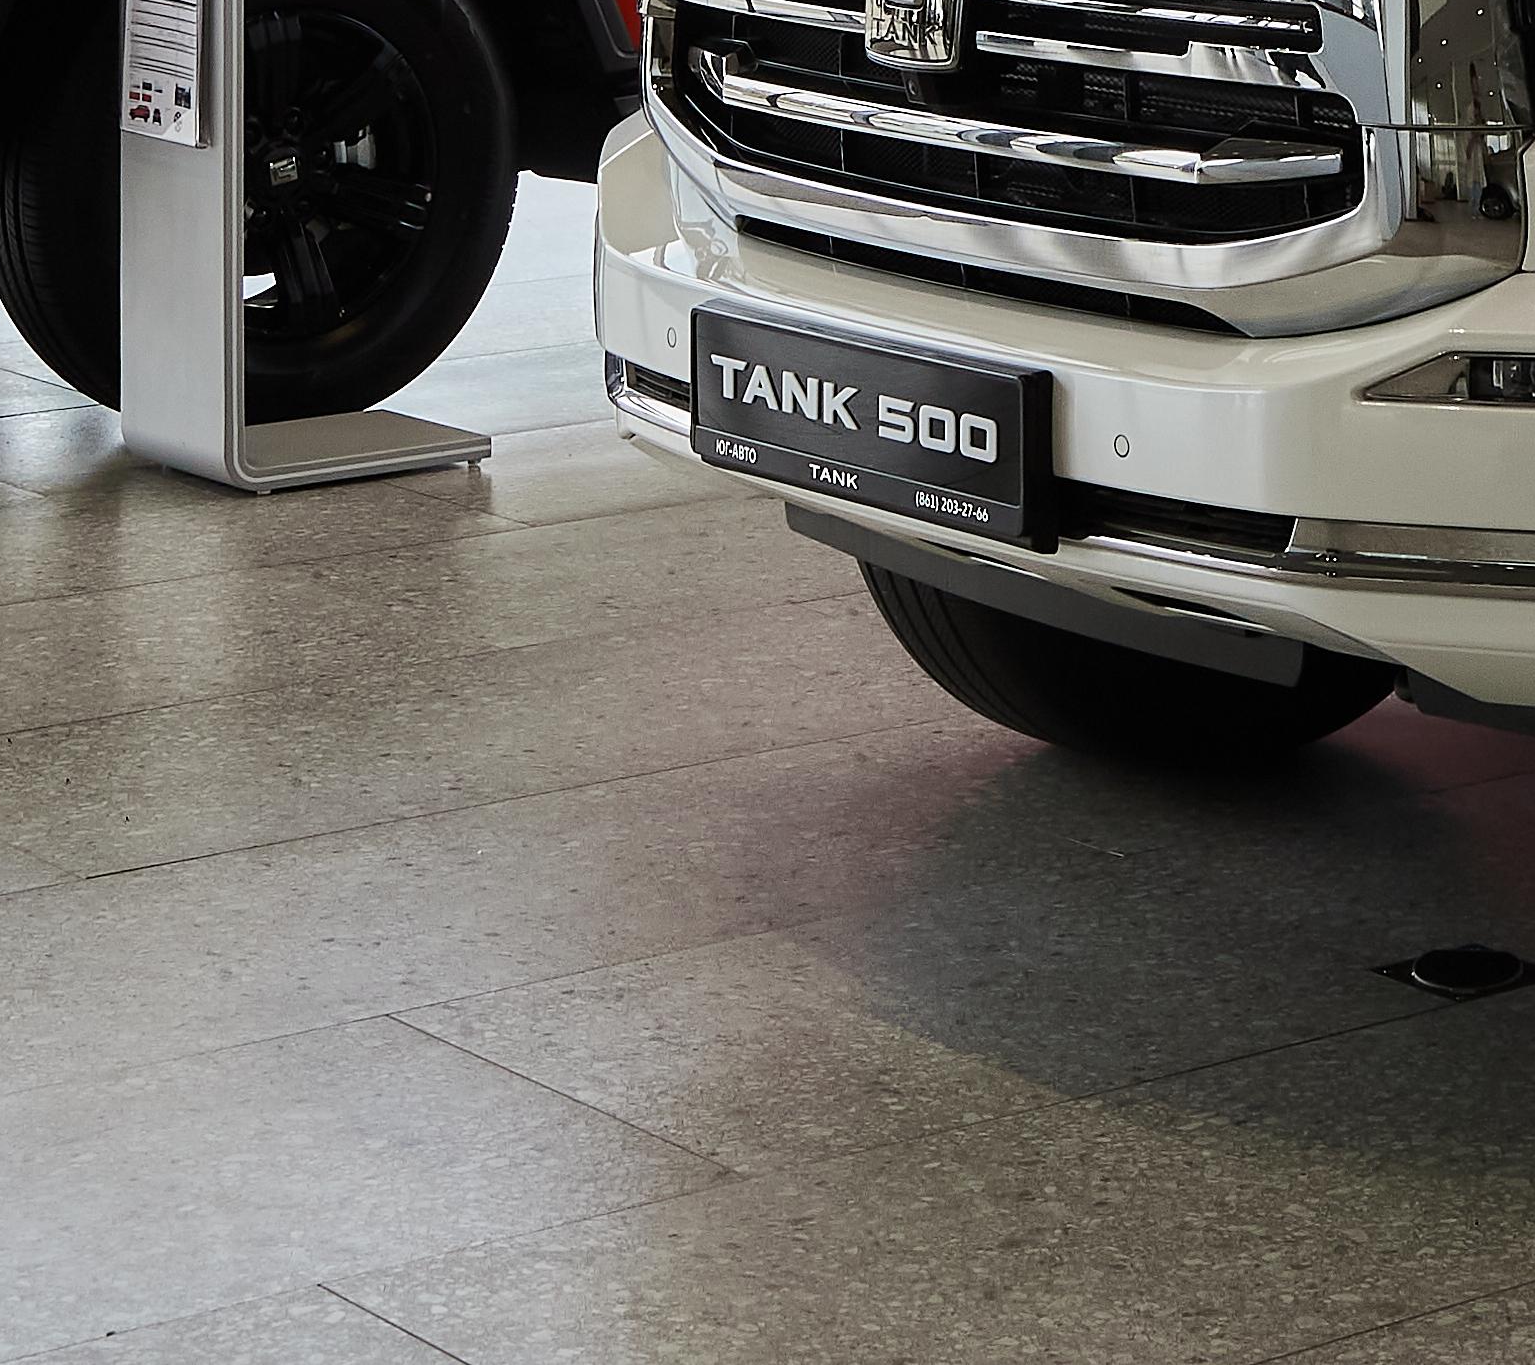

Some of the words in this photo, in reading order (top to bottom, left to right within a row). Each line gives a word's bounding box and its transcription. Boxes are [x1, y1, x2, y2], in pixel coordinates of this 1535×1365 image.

[872, 16, 939, 50] TANK
[710, 353, 861, 431] TANK
[877, 394, 999, 464] 500
[715, 438, 757, 465] ЮГ-АВТО
[808, 463, 859, 490] TANK
[915, 491, 940, 513] (861)
[940, 497, 989, 523] 203-27-66
